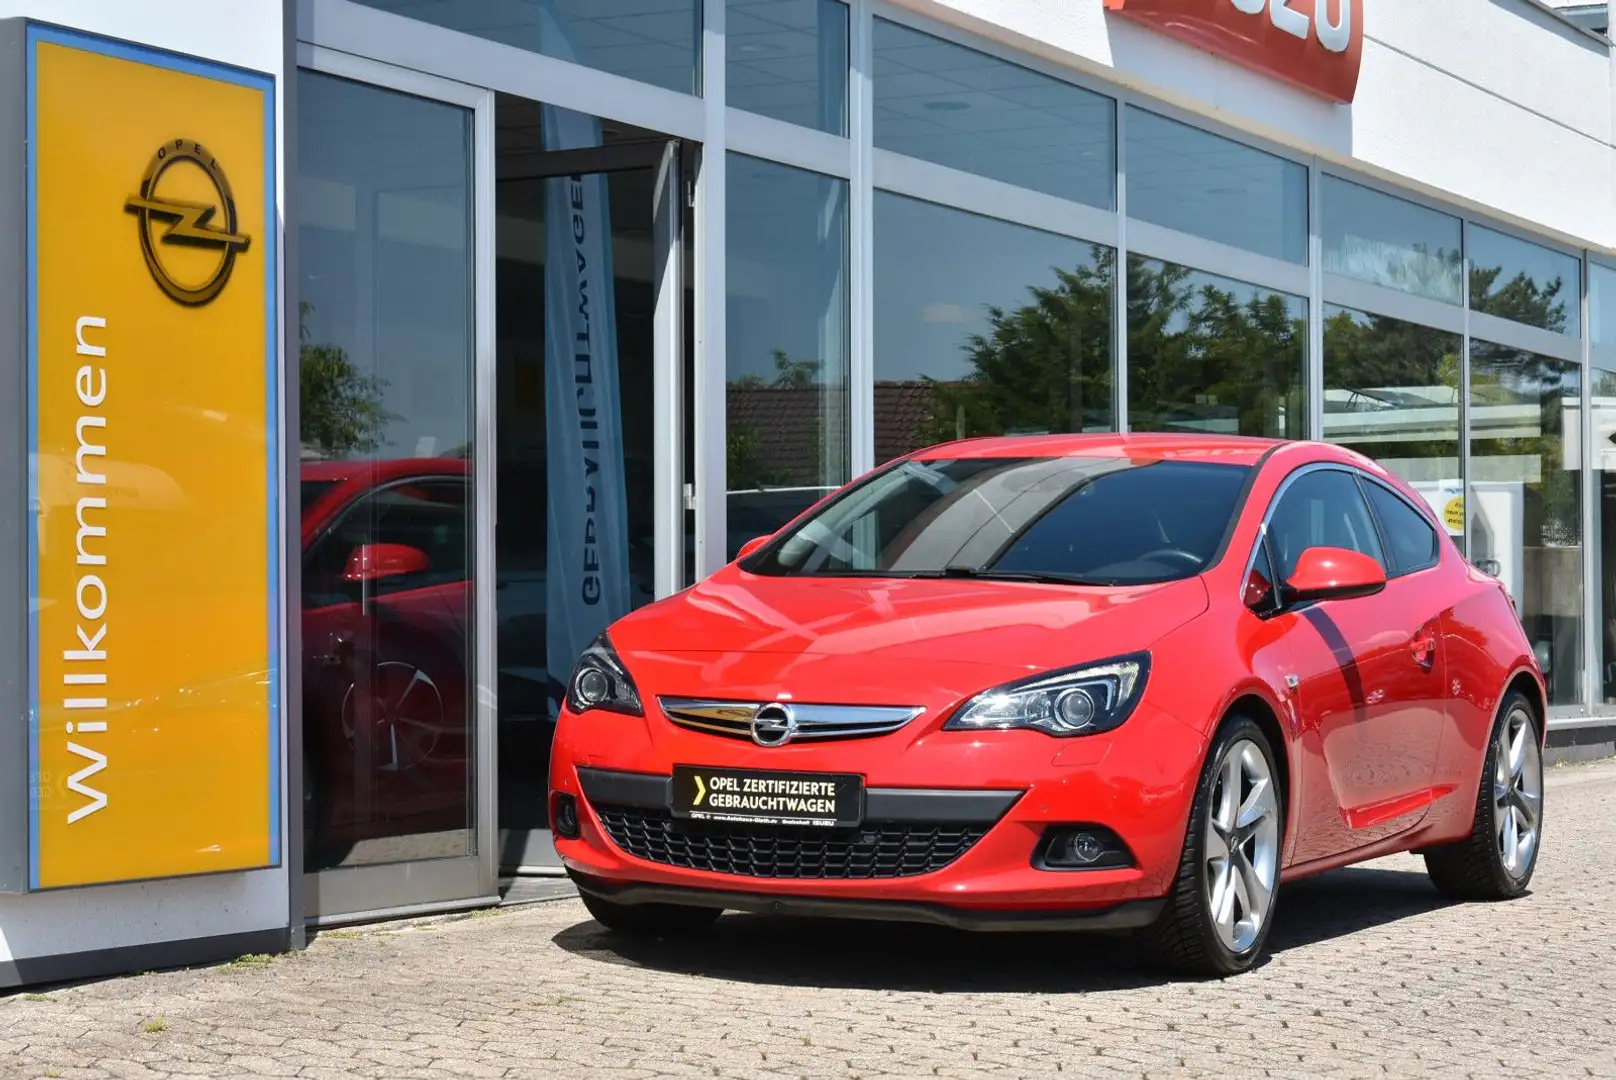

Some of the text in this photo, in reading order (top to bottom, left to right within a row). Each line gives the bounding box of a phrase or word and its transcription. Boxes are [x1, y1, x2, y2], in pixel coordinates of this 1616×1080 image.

[157, 138, 218, 171] OPEL
[63, 315, 107, 825] Willkommen
[709, 777, 836, 796] OPEL ZERTIFIZIERTE
[709, 793, 835, 812] GEBRAUCHTWAGEN
